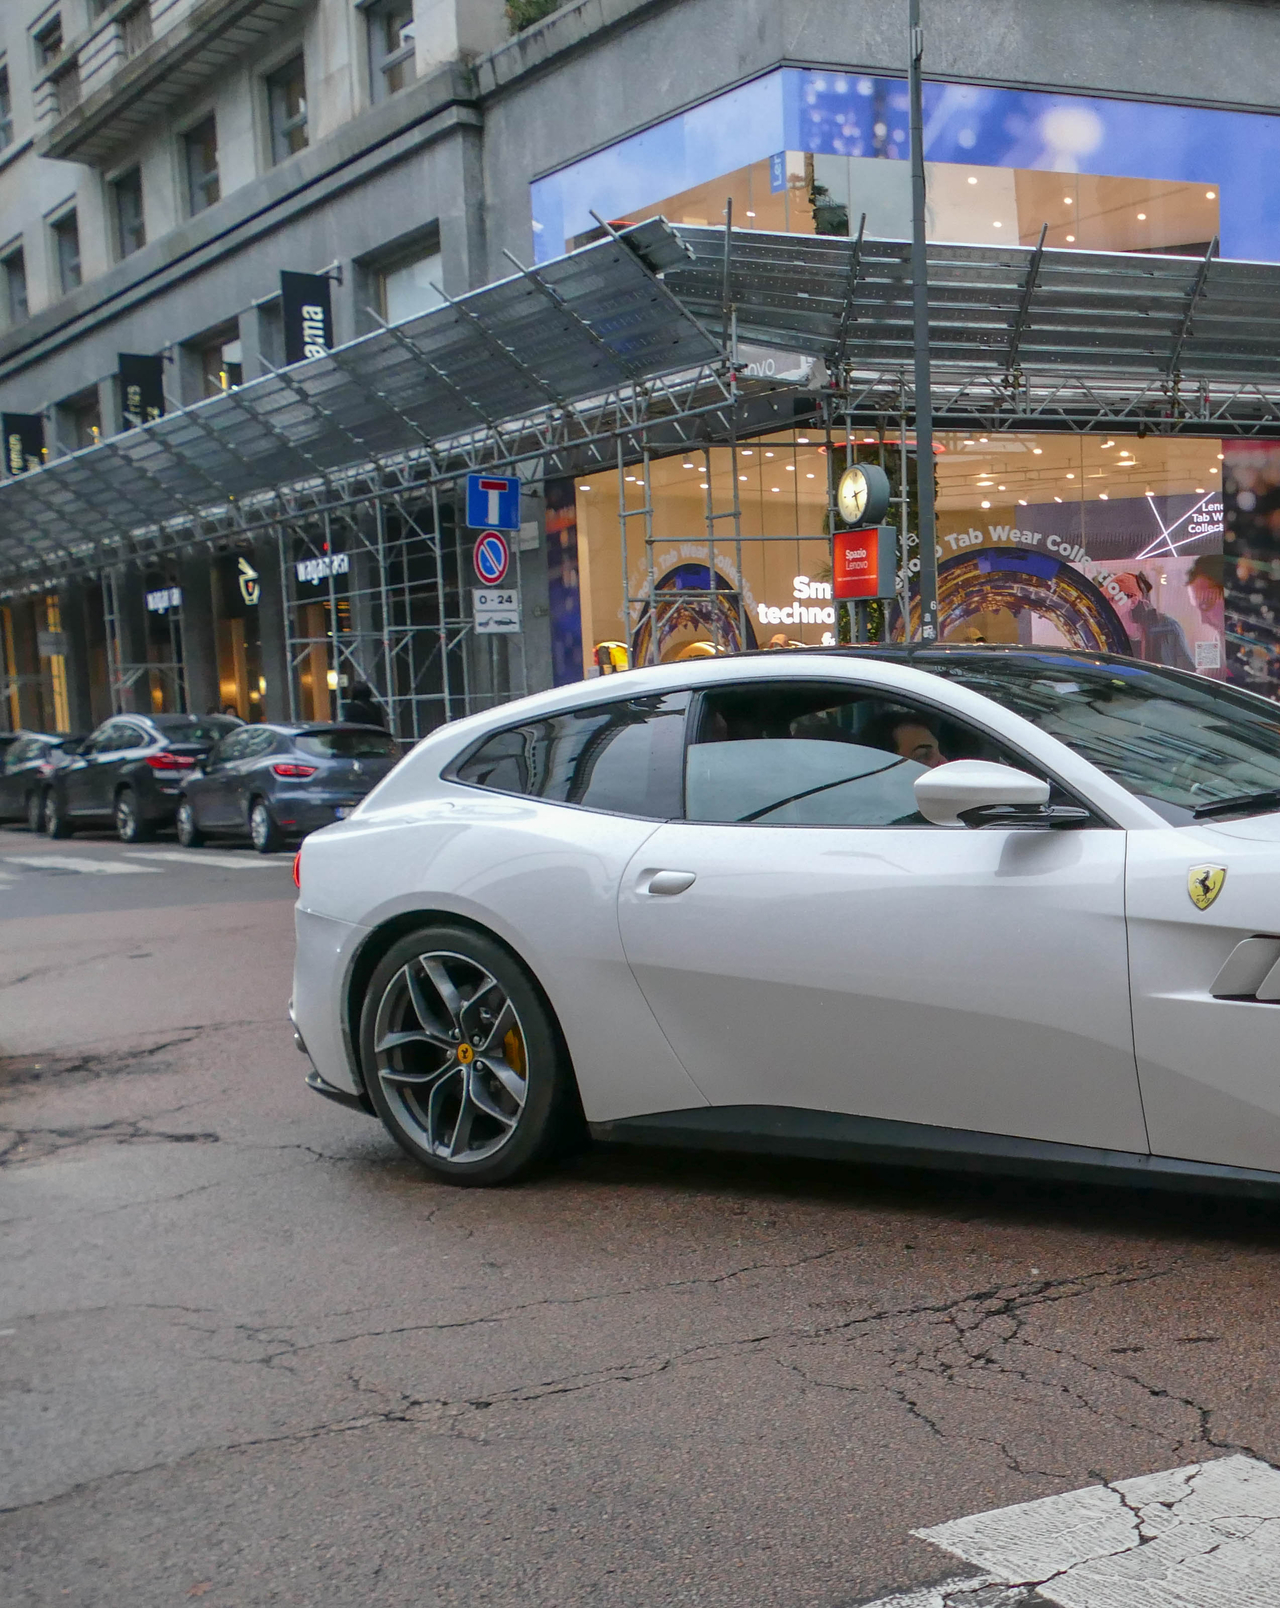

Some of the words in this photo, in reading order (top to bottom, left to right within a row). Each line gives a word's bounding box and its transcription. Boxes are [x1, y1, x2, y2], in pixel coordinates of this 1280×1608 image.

[1192, 513, 1210, 522] Tab
[945, 528, 984, 550] Tab
[988, 525, 1042, 545] Wear
[846, 548, 867, 560] Spazio
[846, 561, 868, 570] Lenovo
[480, 595, 487, 604] 0
[498, 595, 512, 604] 24
[931, 601, 936, 610] 6
